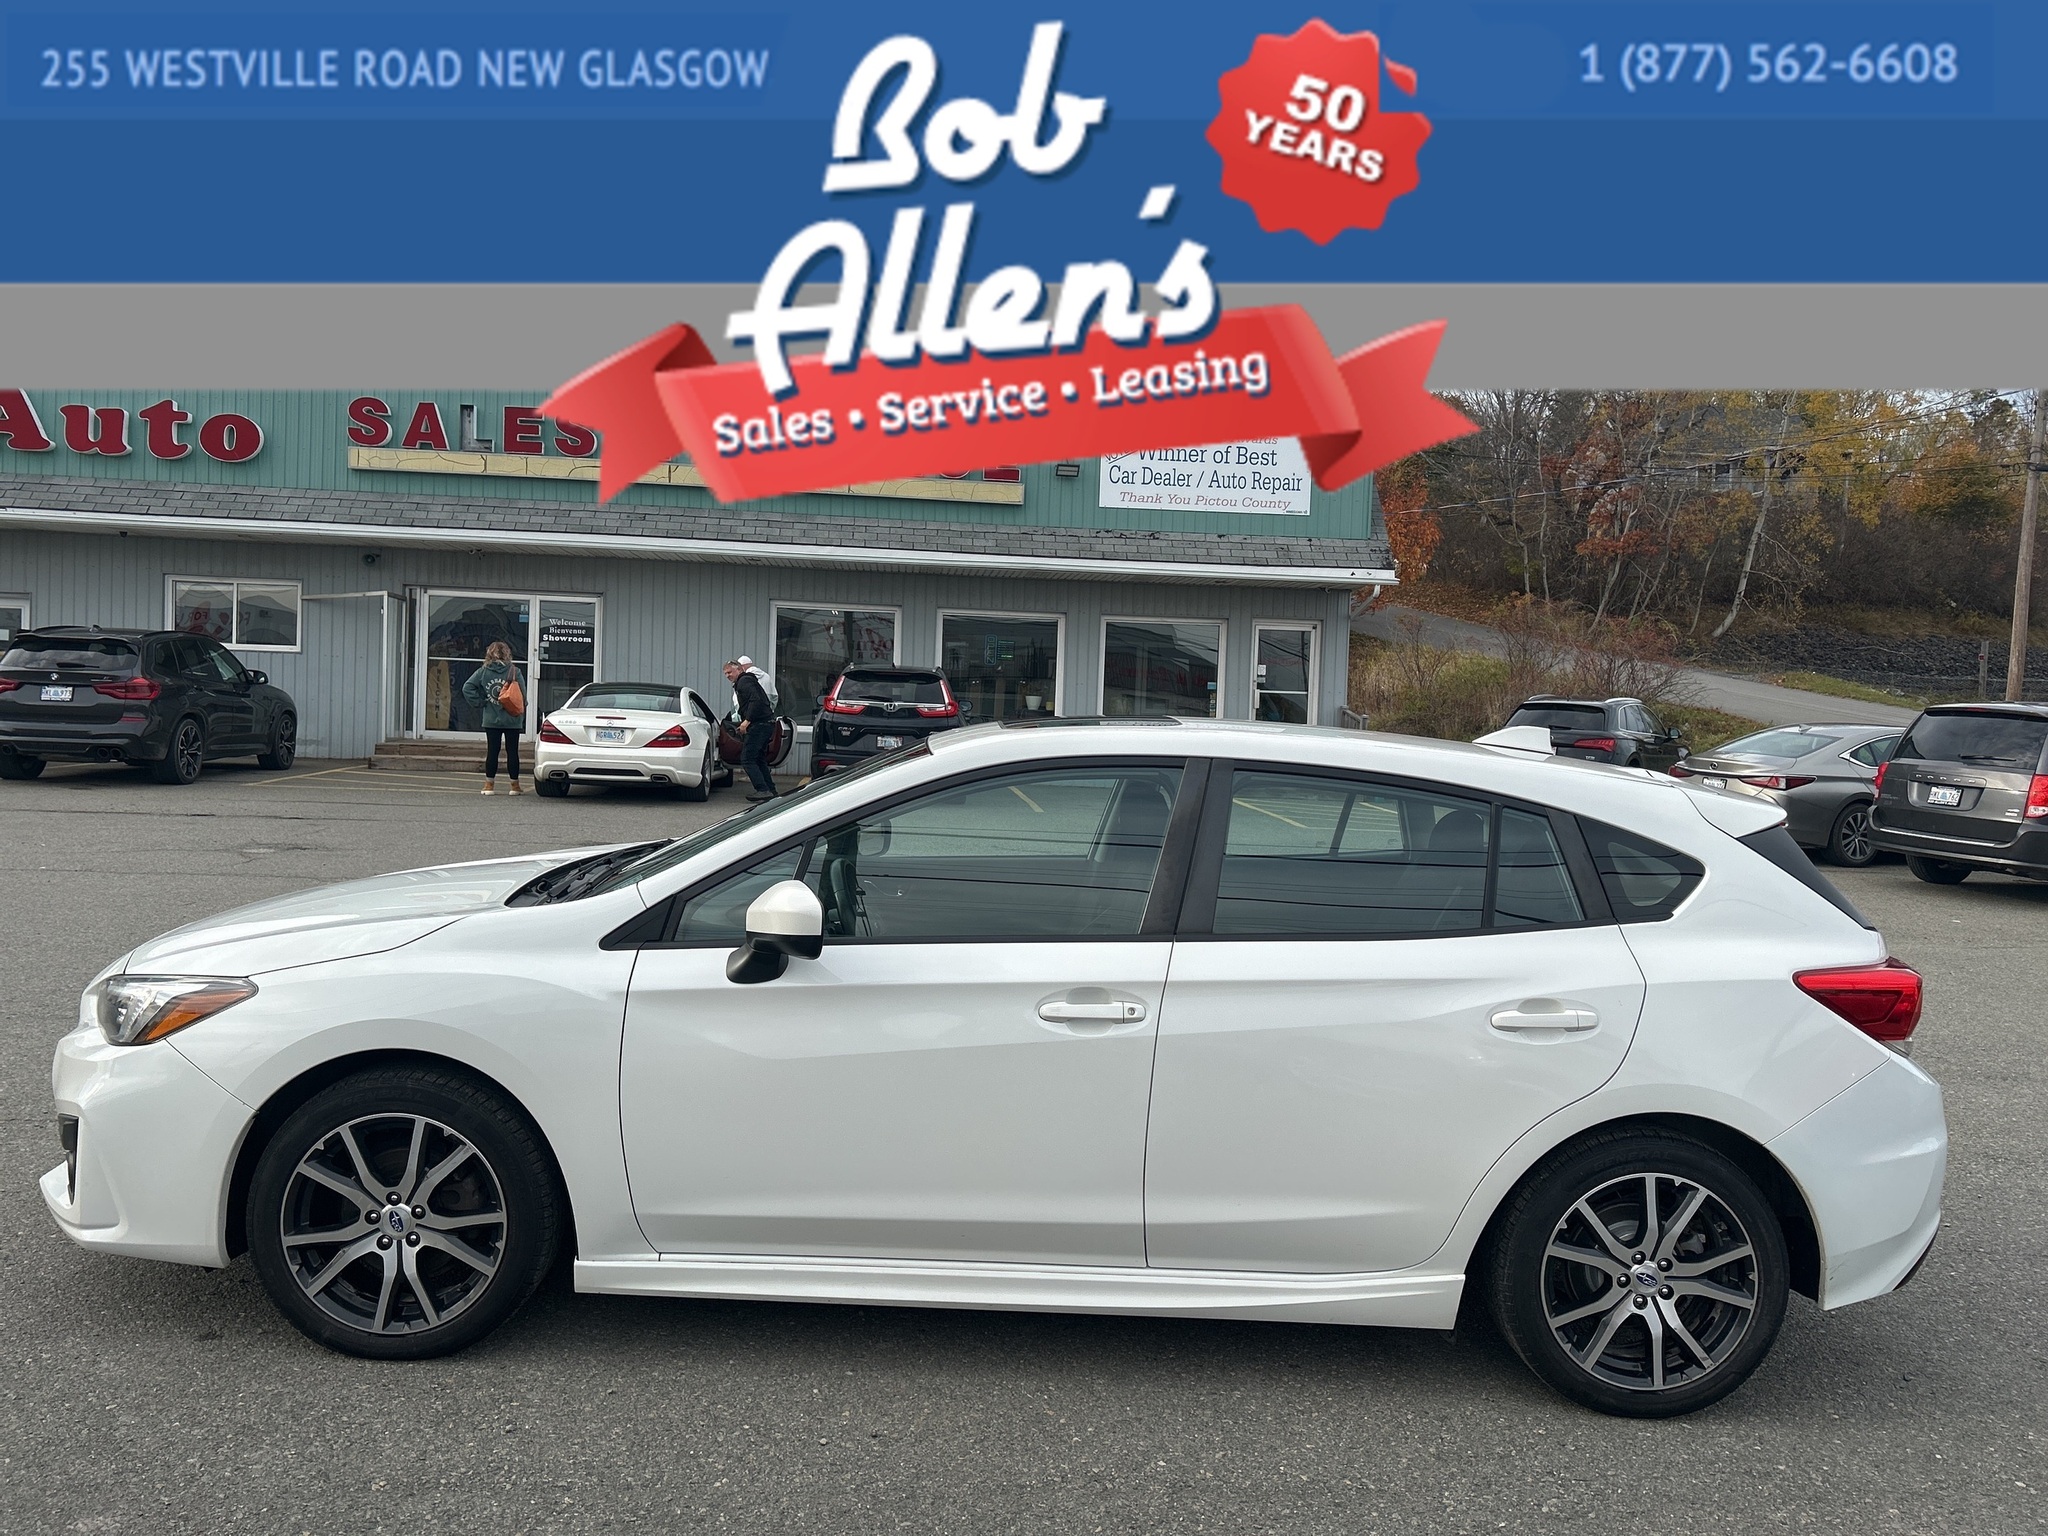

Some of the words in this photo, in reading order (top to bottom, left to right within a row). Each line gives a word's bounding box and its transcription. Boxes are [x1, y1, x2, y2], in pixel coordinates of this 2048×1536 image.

[0, 388, 264, 462] Auto
[347, 396, 598, 457] SALES
[1138, 447, 1208, 464] Winner
[1213, 446, 1232, 464] of
[1236, 446, 1278, 467] Best
[1109, 465, 1137, 485] Car
[1141, 467, 1193, 488] Dealer
[1196, 470, 1205, 488] /
[1208, 470, 1247, 490] Auto
[1251, 471, 1303, 495] Repair
[1119, 491, 1163, 504] Thank
[1167, 494, 1191, 505] You
[1194, 495, 1239, 508] Pictou
[1242, 497, 1291, 511] County
[549, 618, 586, 626] Welcome
[549, 626, 586, 635] Bienvenue
[542, 633, 592, 643] Showroom
